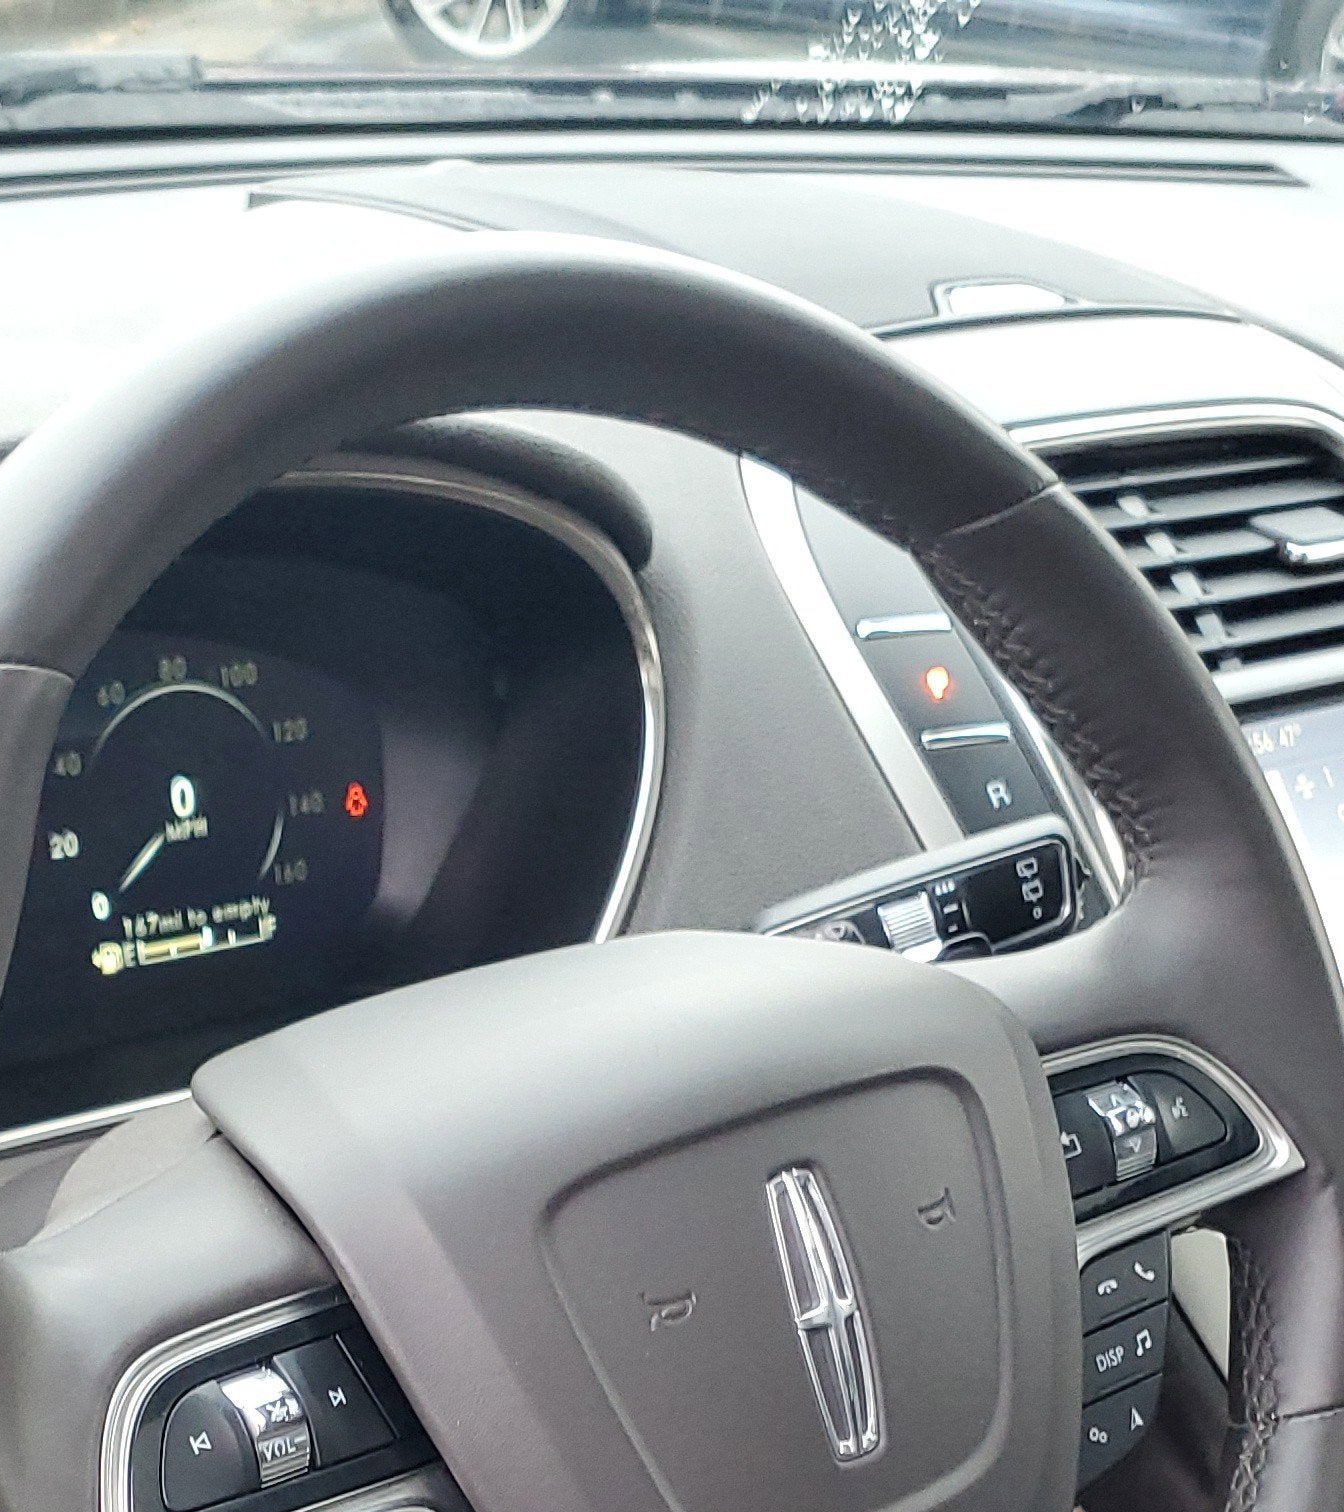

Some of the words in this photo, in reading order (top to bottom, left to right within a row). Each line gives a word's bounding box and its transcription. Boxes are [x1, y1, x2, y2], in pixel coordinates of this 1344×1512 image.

[220, 662, 258, 688] 100
[273, 719, 307, 743] 120
[170, 774, 196, 817] 0
[986, 779, 1013, 809] R
[165, 815, 208, 844] MPH
[49, 831, 80, 861] 20
[91, 891, 111, 921] 0
[187, 902, 207, 925] to
[212, 894, 270, 925] empty
[1095, 1346, 1125, 1373] DISP
[262, 1438, 296, 1464] VOL
